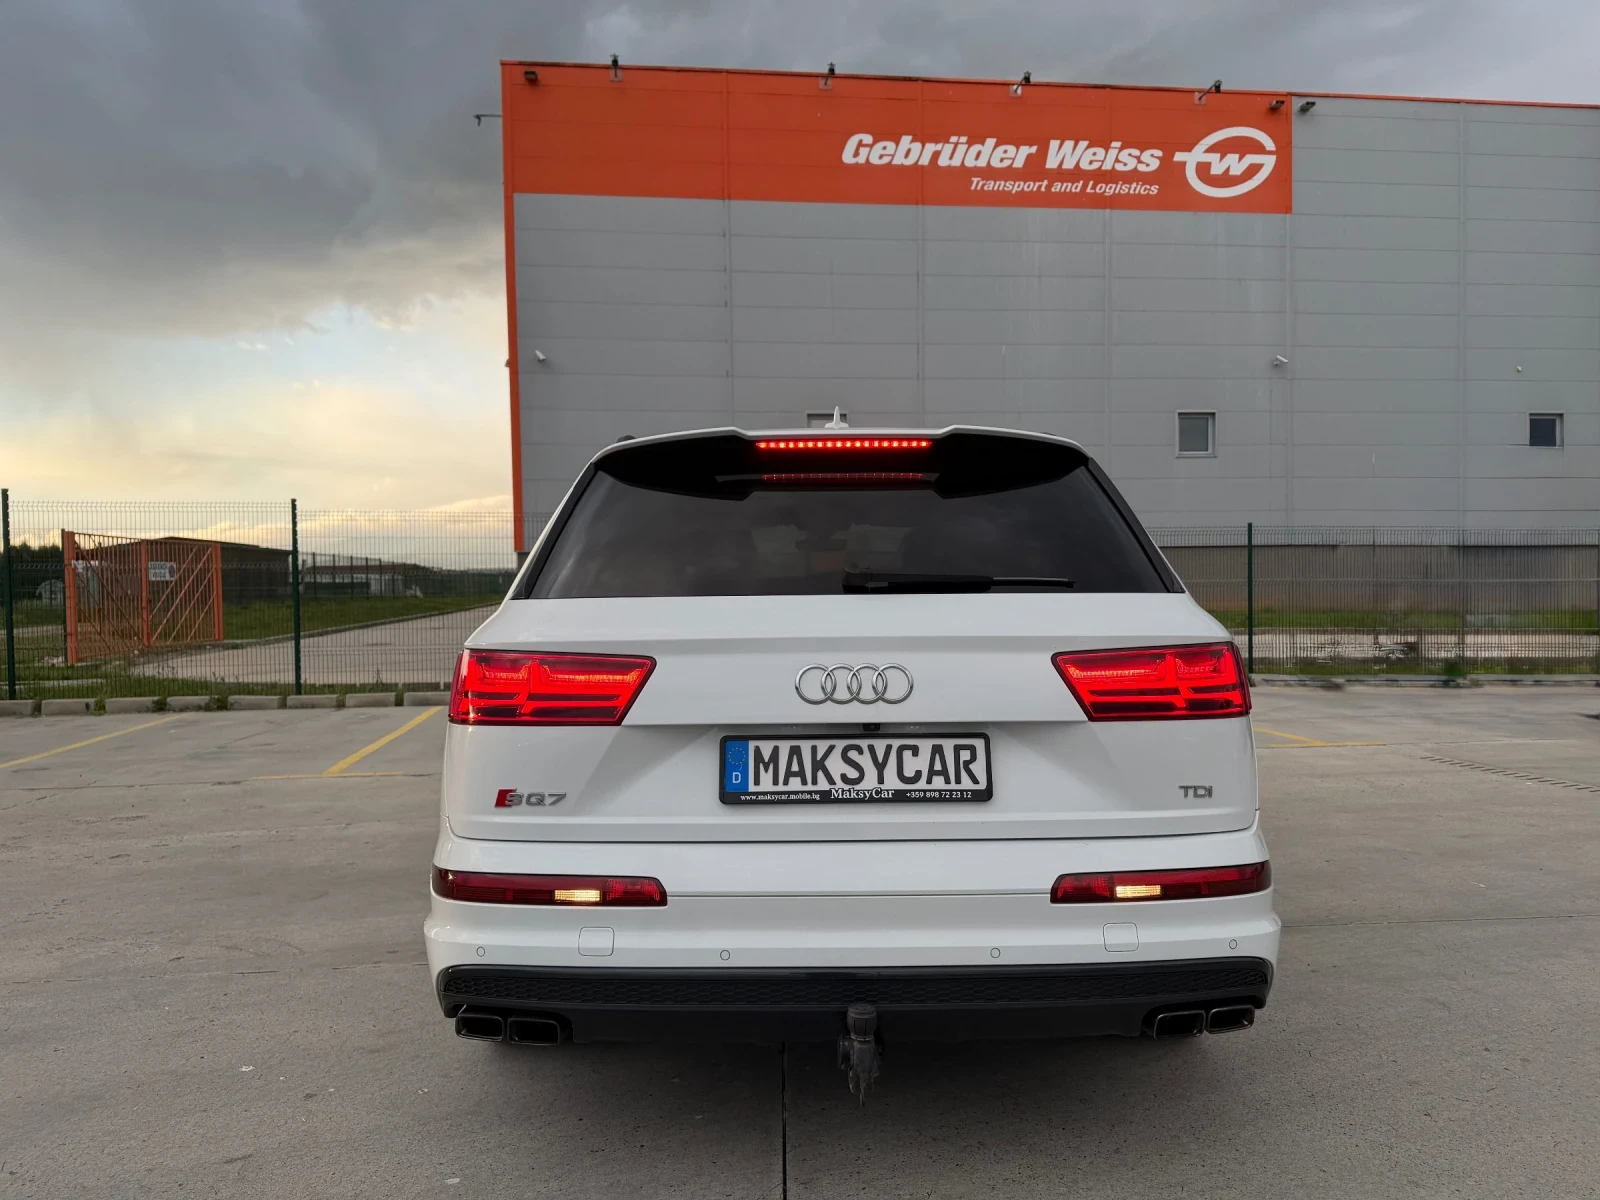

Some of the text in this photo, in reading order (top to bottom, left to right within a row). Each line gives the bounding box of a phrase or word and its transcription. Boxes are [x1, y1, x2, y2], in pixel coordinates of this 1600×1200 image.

[841, 133, 1163, 172] Gebrüder Weiss
[970, 177, 1159, 195] Transport and Logistics
[753, 743, 981, 787] MAKSYCAR
[732, 771, 742, 784] D
[504, 791, 567, 807] SQ7
[740, 793, 821, 801] www.maksycar.mobile.bg
[830, 787, 895, 800] MaksyCar
